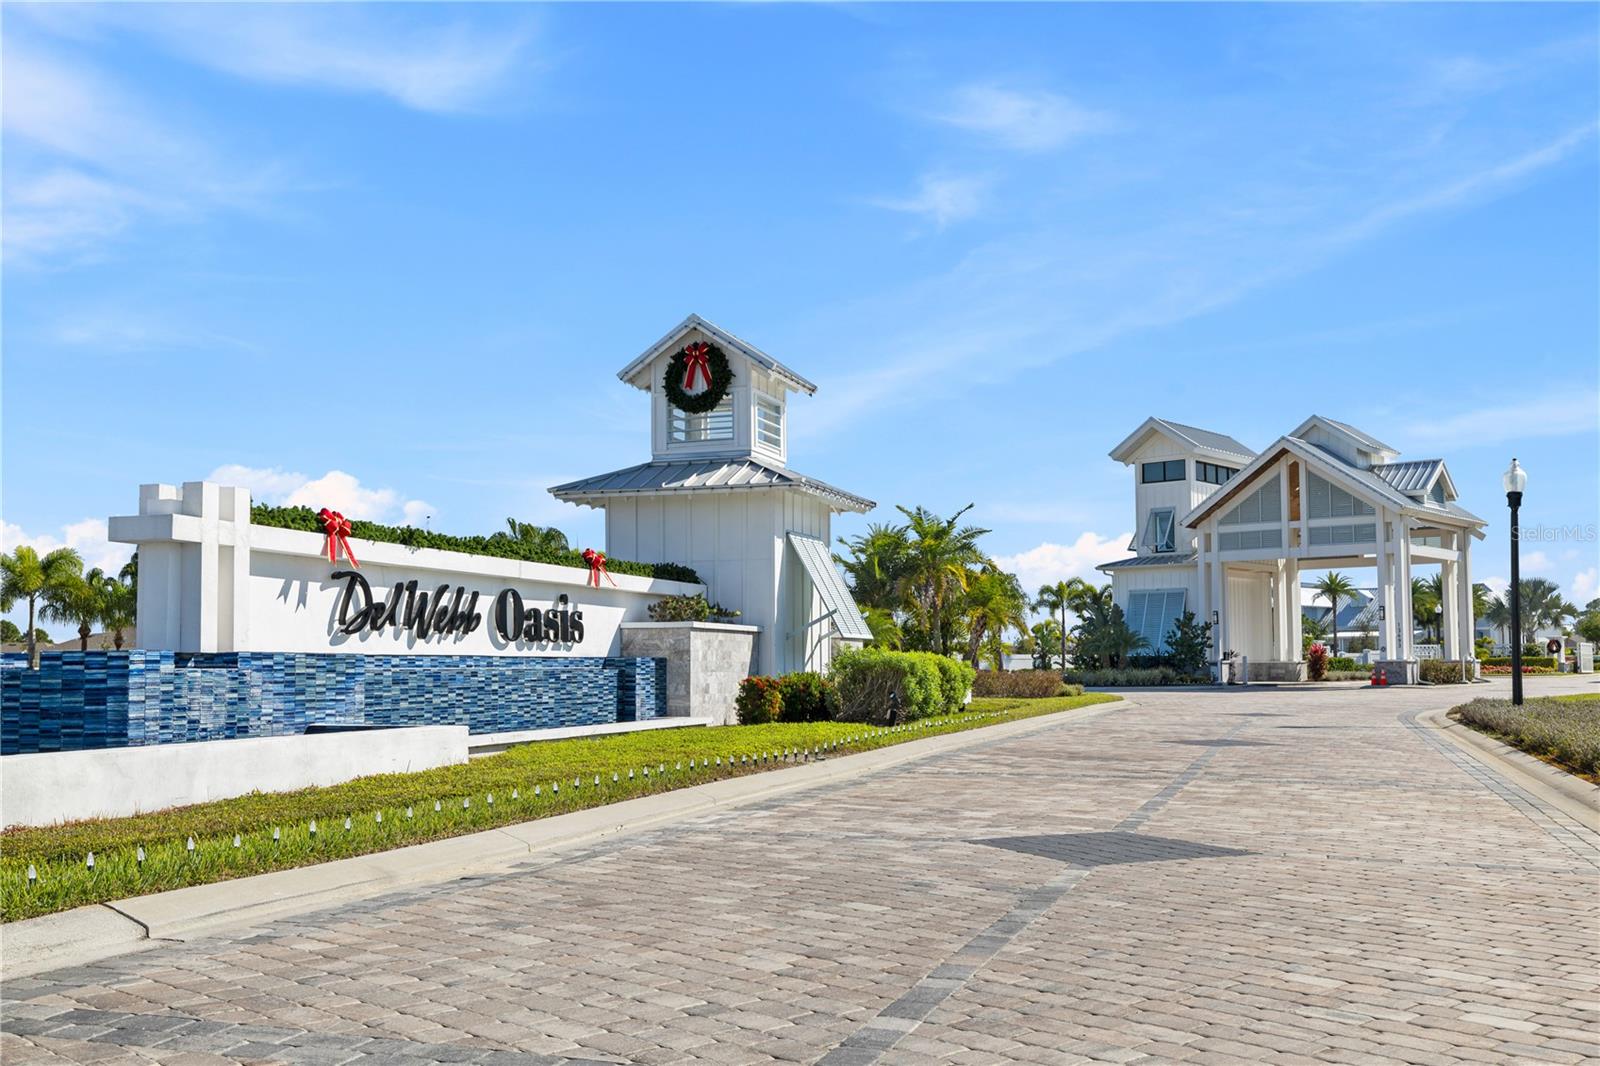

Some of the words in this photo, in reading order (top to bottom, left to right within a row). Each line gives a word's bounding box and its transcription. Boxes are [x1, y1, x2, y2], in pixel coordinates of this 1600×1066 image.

[331, 571, 404, 635] Del
[405, 580, 482, 640] Webb
[495, 588, 584, 643] Oasis
